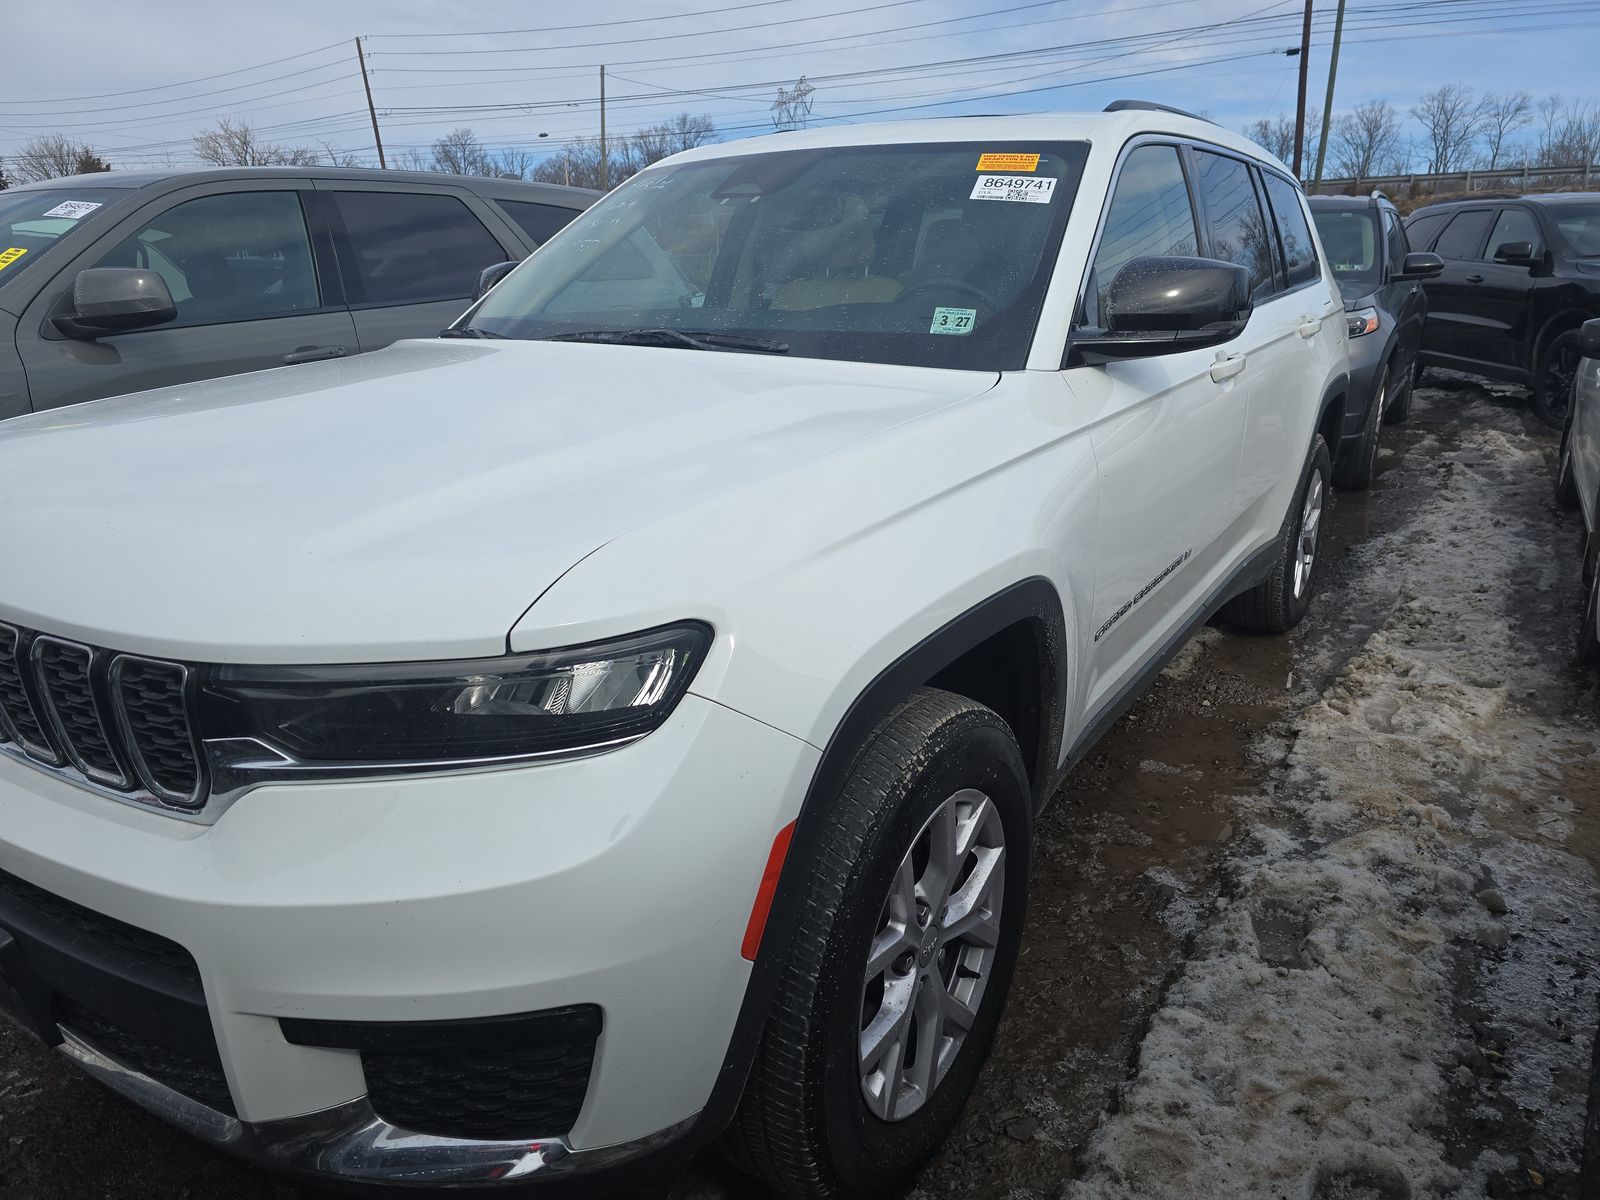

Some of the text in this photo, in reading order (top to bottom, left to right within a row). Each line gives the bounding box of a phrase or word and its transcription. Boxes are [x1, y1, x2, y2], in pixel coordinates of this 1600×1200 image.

[984, 178, 1052, 190] 8649741
[940, 315, 971, 328] 3 27
